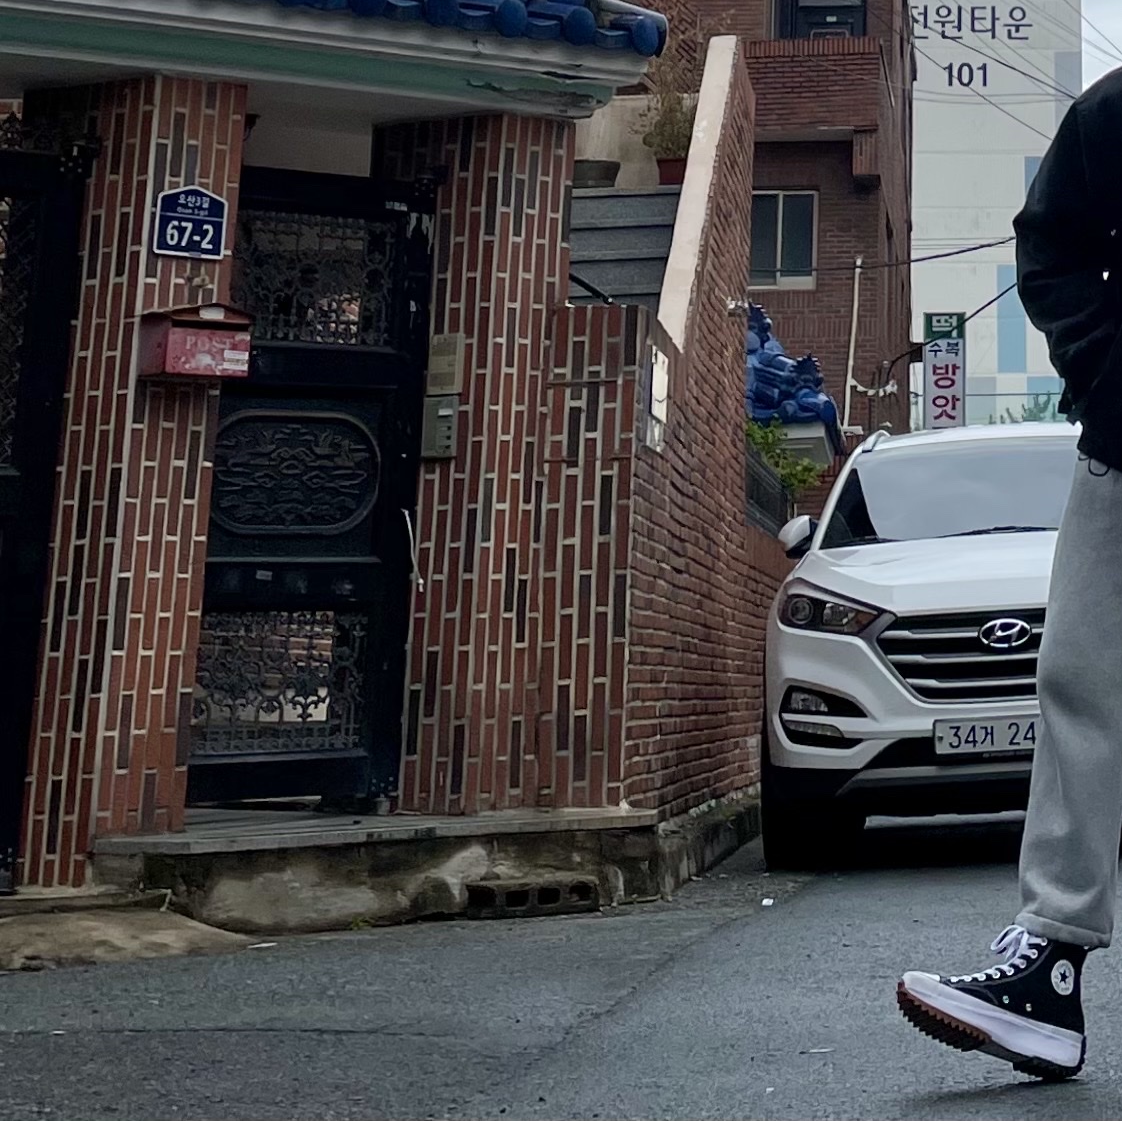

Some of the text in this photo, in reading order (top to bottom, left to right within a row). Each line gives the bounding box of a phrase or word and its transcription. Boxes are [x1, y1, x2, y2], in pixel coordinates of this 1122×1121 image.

[943, 62, 987, 87] 101
[166, 220, 214, 250] 67-2
[931, 315, 958, 338] 떡
[927, 341, 960, 358] 수복
[931, 363, 961, 429] 방앗
[948, 724, 995, 749] 34거
